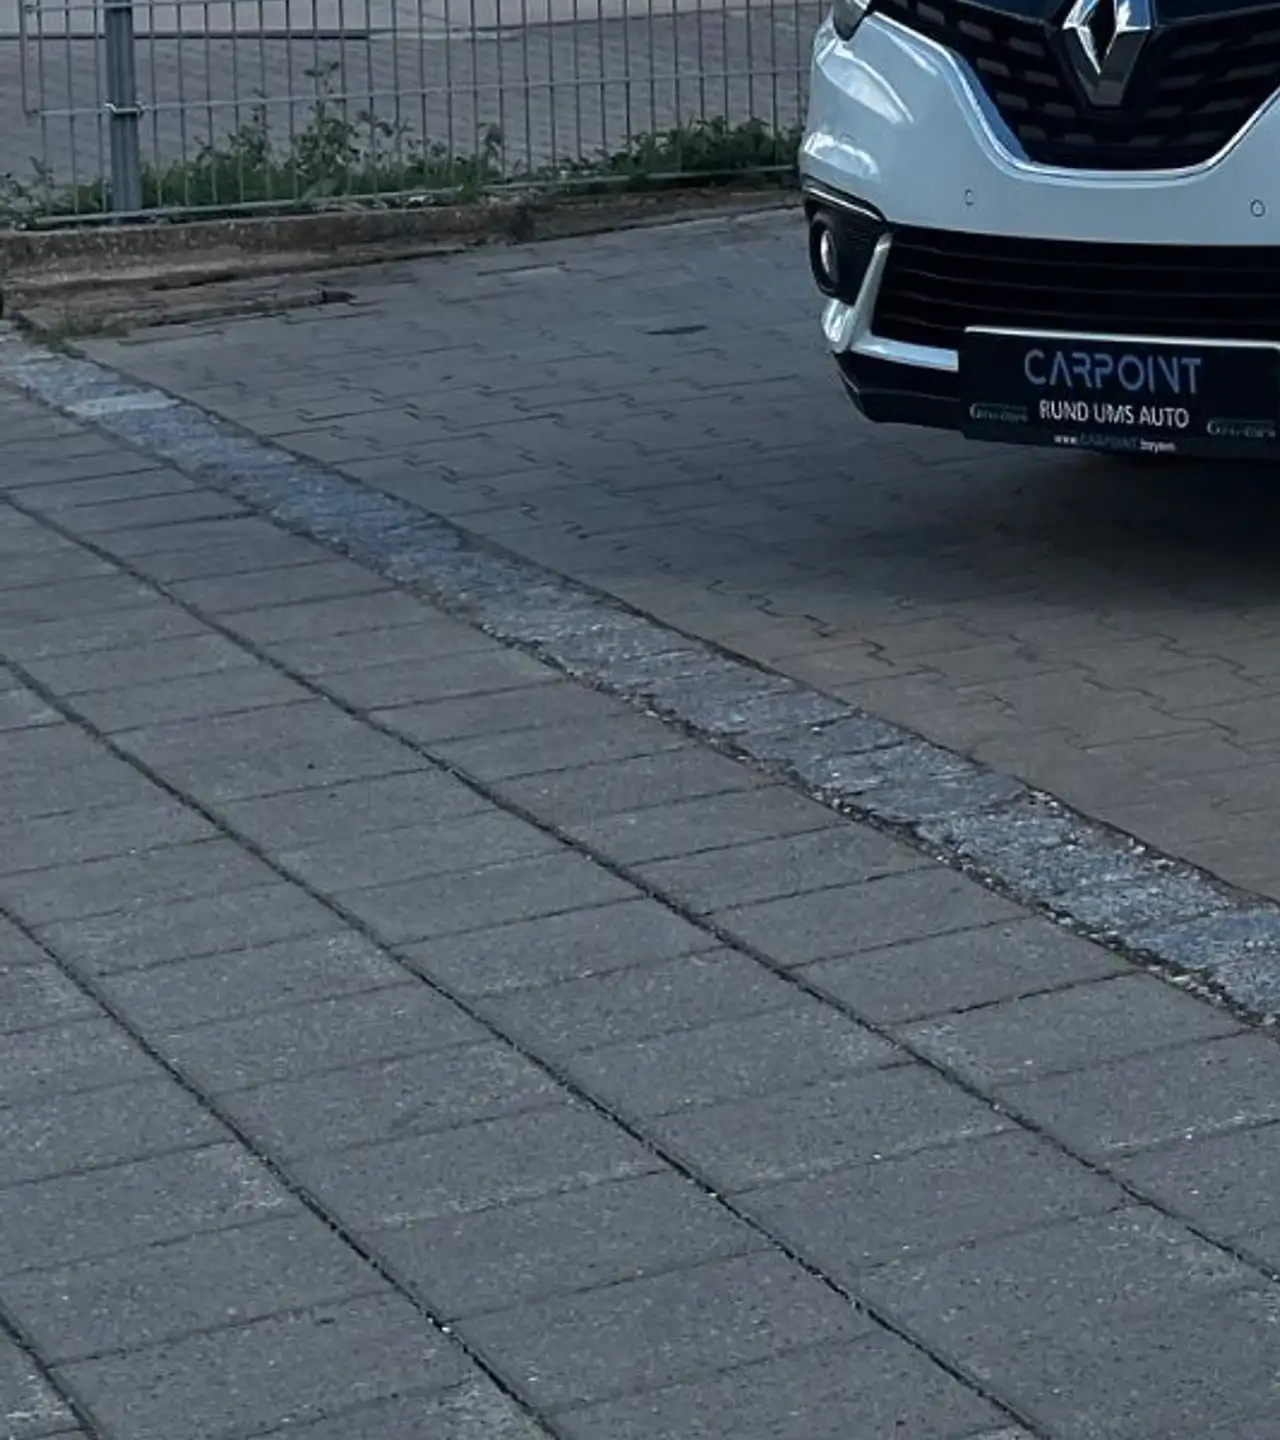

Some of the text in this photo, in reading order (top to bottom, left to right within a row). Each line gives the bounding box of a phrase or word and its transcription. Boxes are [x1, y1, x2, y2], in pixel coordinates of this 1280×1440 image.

[1023, 348, 1202, 395] CARPOINT
[1039, 398, 1089, 422] RUND
[1093, 402, 1136, 425] UMS
[1139, 405, 1190, 428] AUTO
